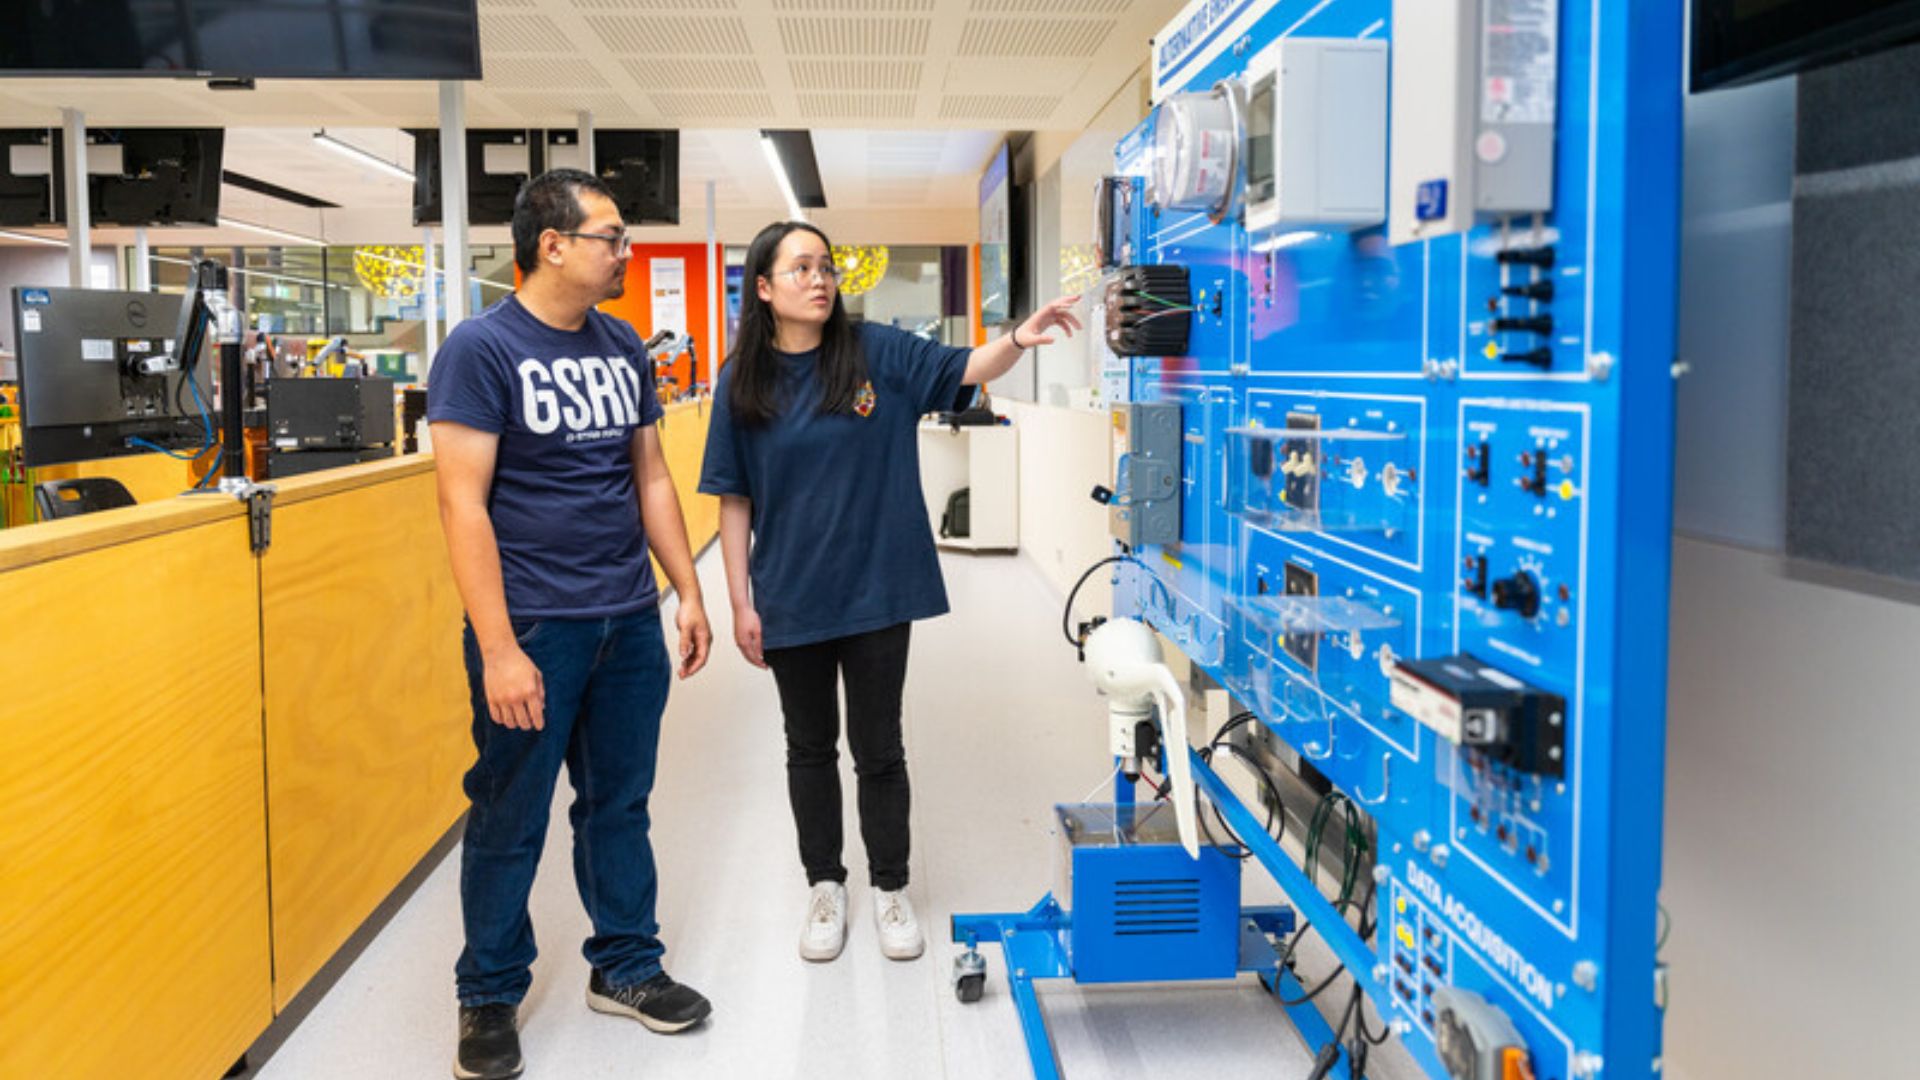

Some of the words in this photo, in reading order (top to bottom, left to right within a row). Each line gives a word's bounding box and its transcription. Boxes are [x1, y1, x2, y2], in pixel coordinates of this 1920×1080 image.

[518, 356, 641, 434] GSRD
[1407, 859, 1443, 911] DATA
[1444, 894, 1553, 1009] ACQUISITION
